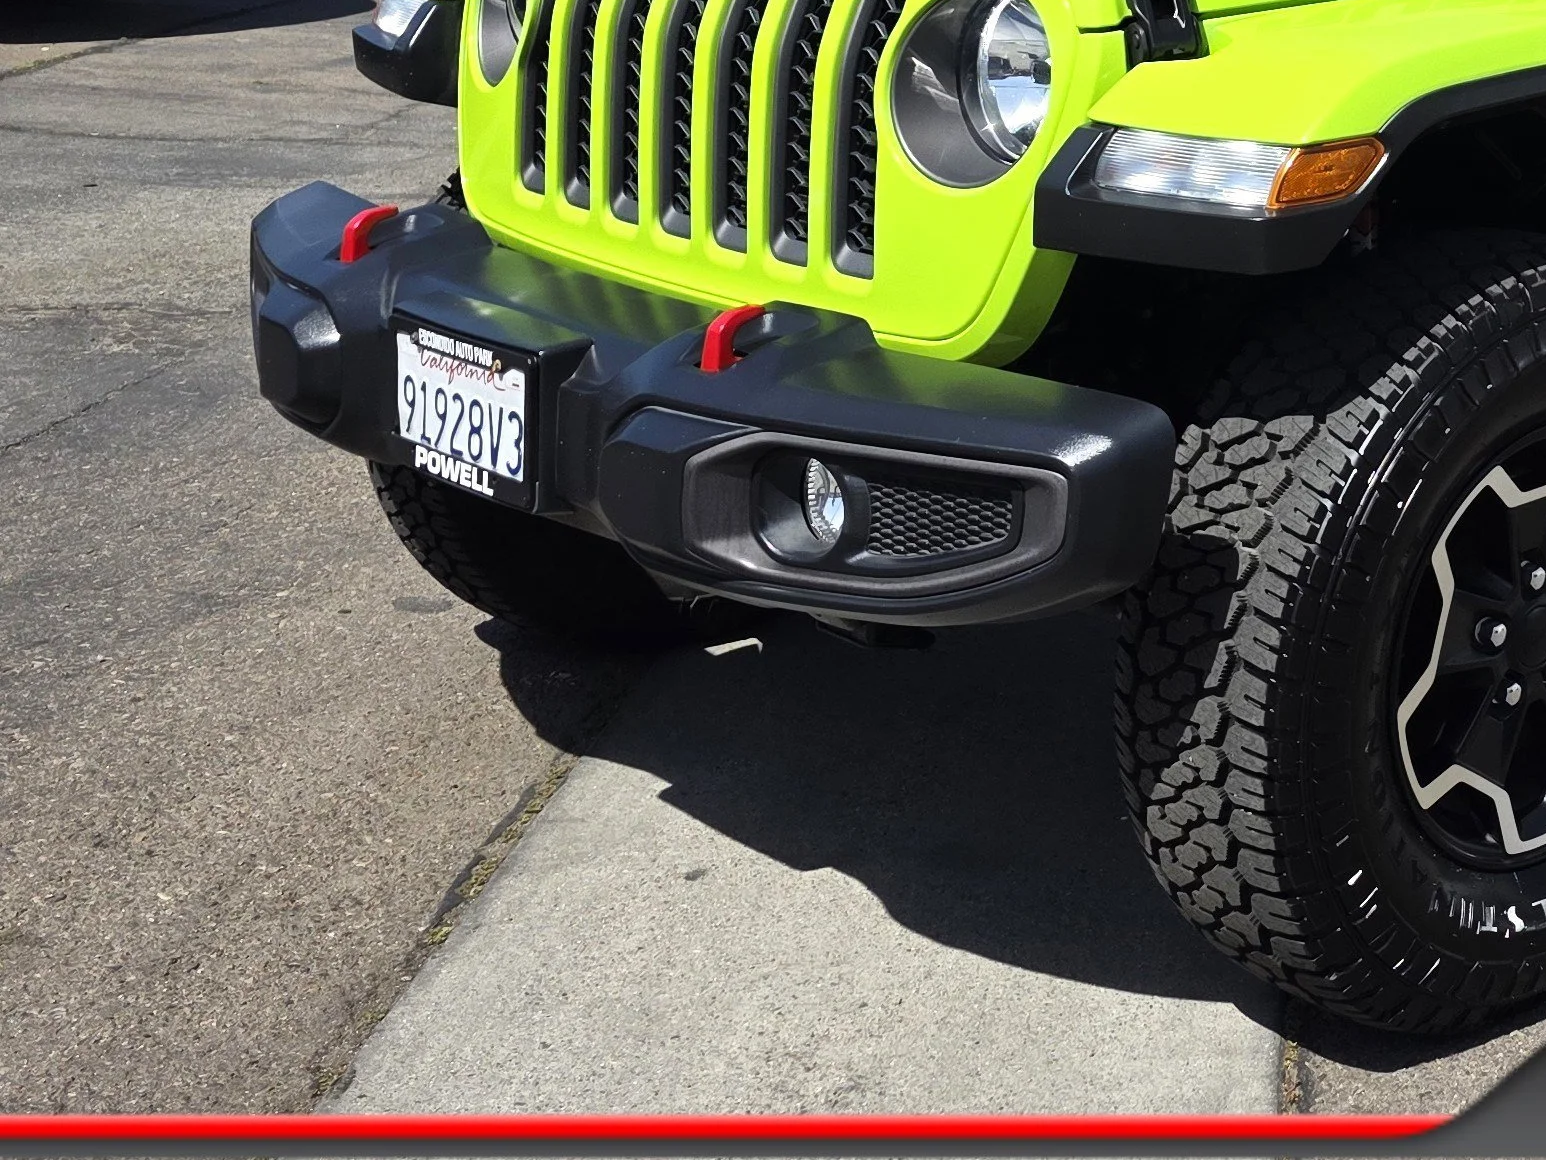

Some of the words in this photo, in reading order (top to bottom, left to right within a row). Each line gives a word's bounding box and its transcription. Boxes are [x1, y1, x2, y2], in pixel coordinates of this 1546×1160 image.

[418, 327, 455, 356] ESCONDIDO
[455, 340, 474, 362] AUTO
[474, 346, 494, 367] PARK
[403, 373, 524, 476] 91928V3
[414, 444, 495, 497] POWELL
